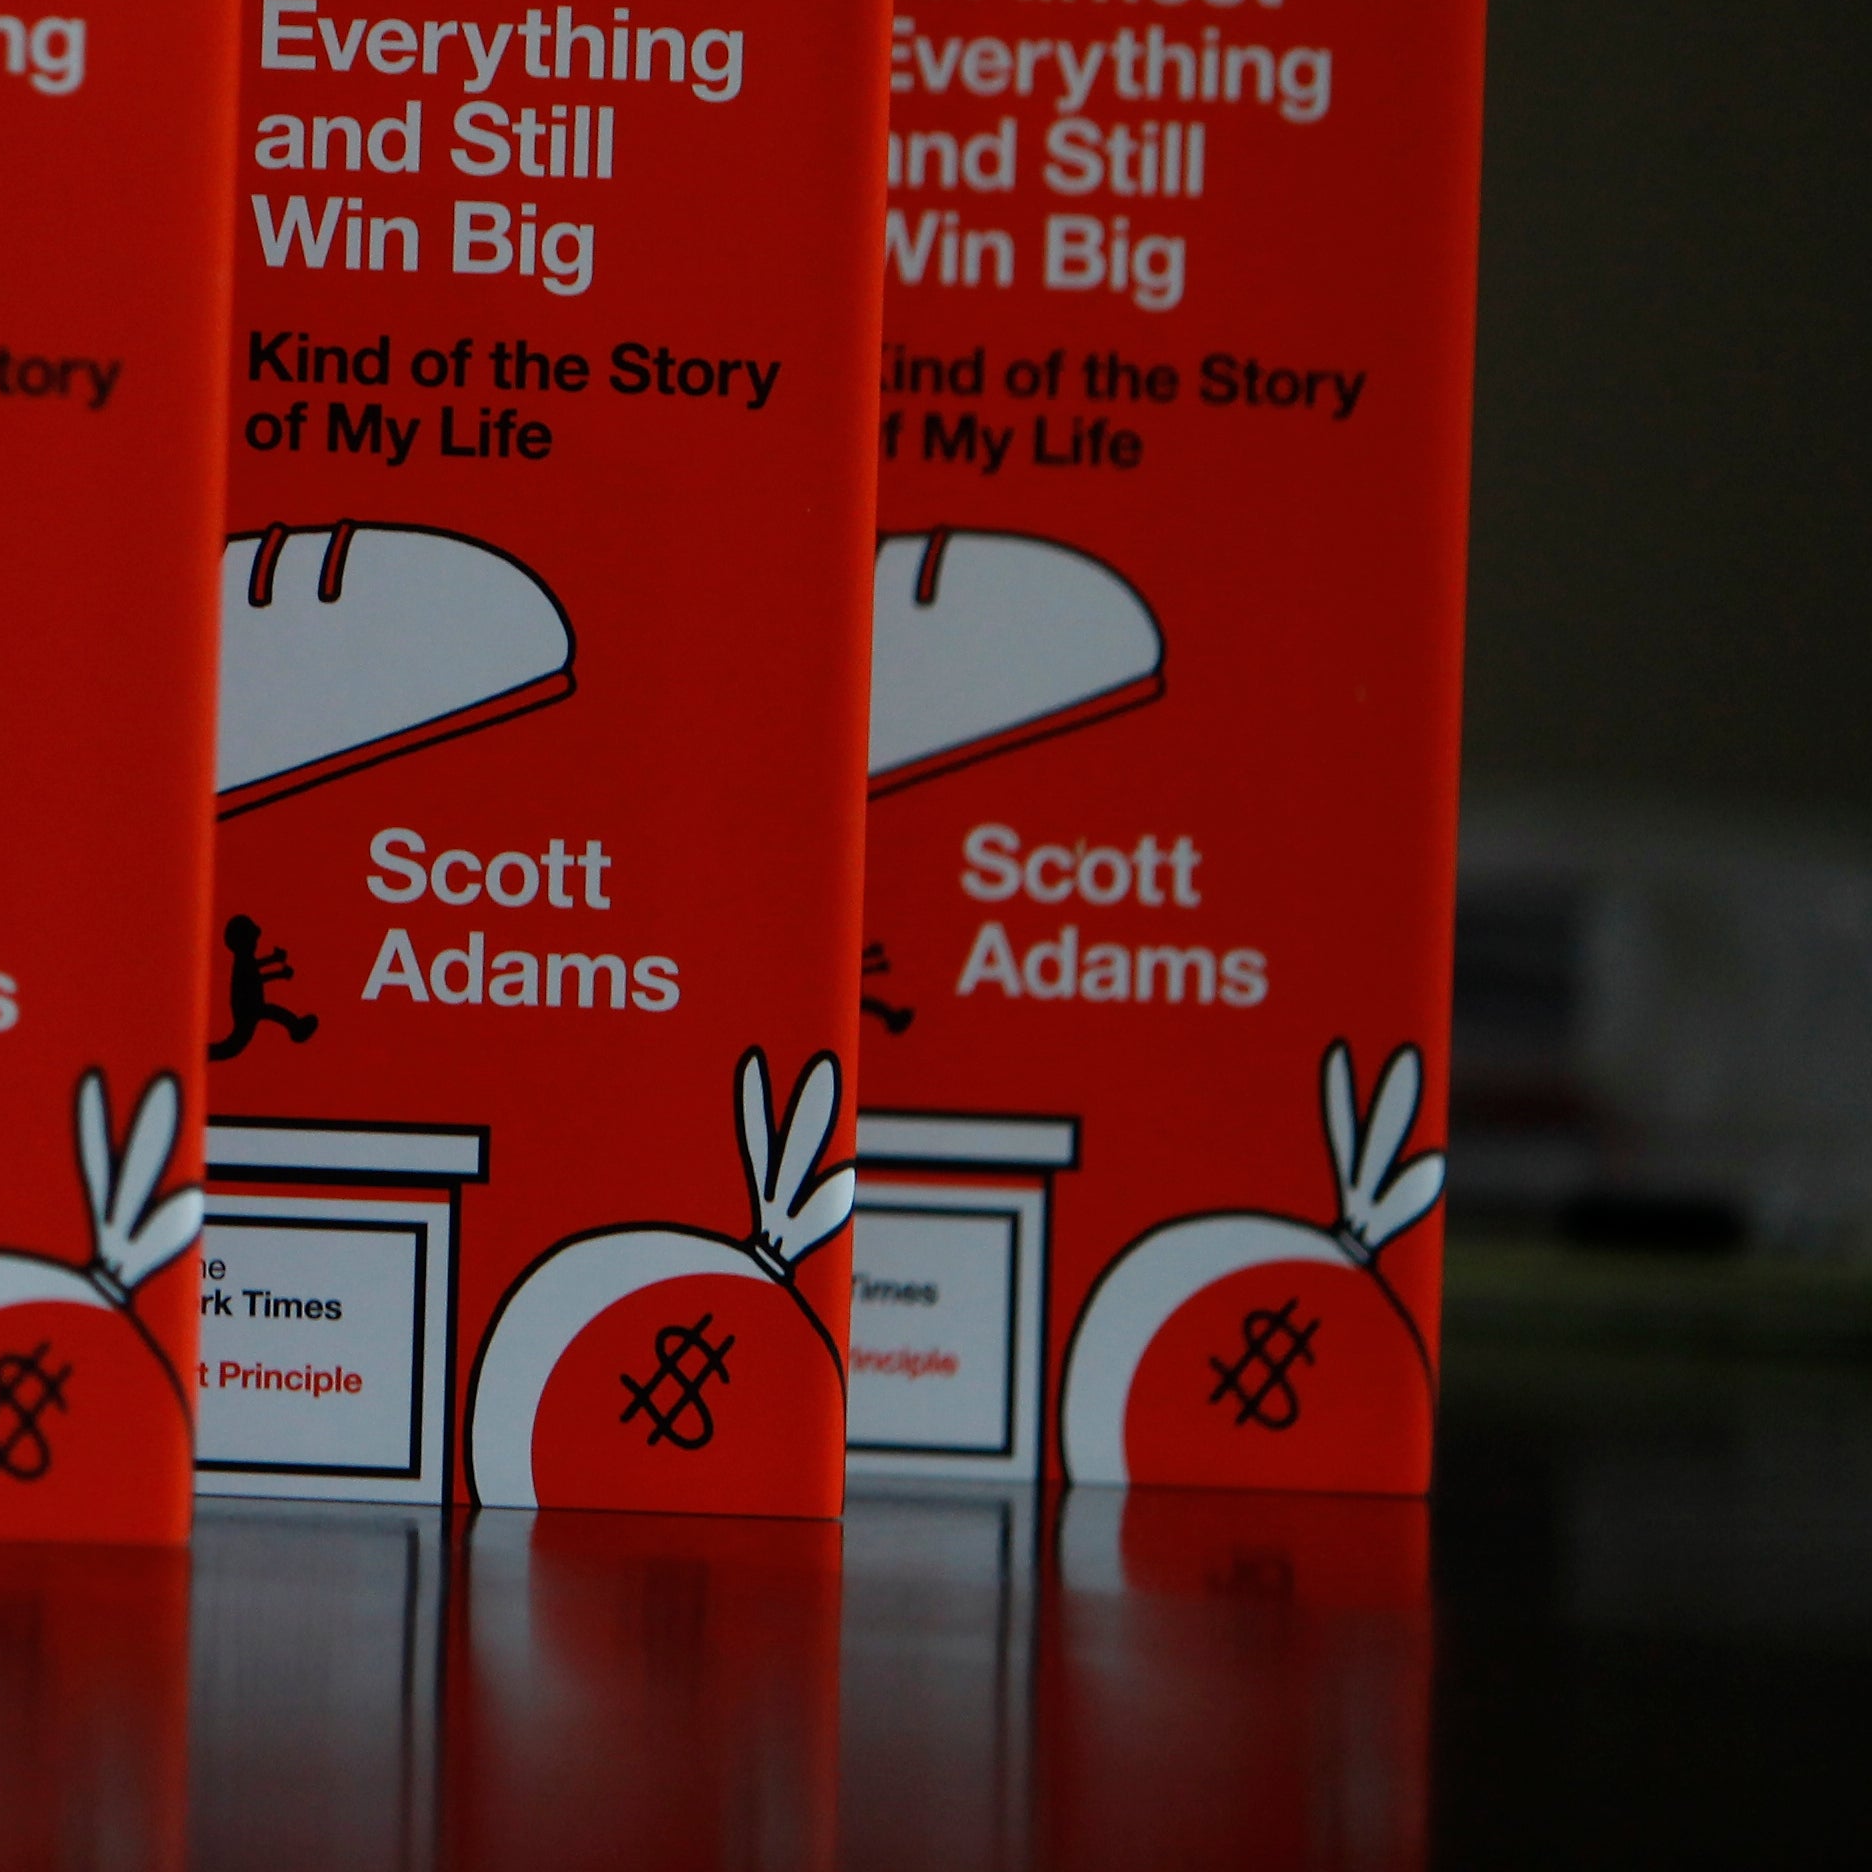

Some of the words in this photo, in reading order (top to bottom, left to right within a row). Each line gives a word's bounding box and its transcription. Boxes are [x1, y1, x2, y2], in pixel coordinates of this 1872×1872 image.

[254, 100, 422, 174] and
[450, 100, 615, 180] Still
[1044, 117, 1205, 197] Still
[251, 194, 420, 272] Win
[452, 200, 595, 297] Big
[1045, 215, 1186, 311] Big
[248, 330, 391, 386] Kind
[410, 337, 474, 388] of
[488, 339, 590, 393] the
[609, 341, 781, 411] Story
[883, 344, 985, 397] ind
[1004, 349, 1065, 400] of
[1082, 351, 1180, 404] the
[1199, 353, 1367, 421] Story
[244, 401, 309, 452] of
[327, 401, 421, 467] My
[440, 405, 553, 461] Life
[882, 410, 903, 460] f
[922, 414, 1014, 475] My
[1033, 417, 1144, 470] Life
[366, 827, 612, 910] Scott
[962, 824, 1201, 907] Scott
[361, 928, 681, 1013] Adams
[957, 923, 1269, 1007] Adams
[202, 1288, 233, 1316] rk
[241, 1288, 342, 1321] Times
[218, 1361, 363, 1399] Principle
